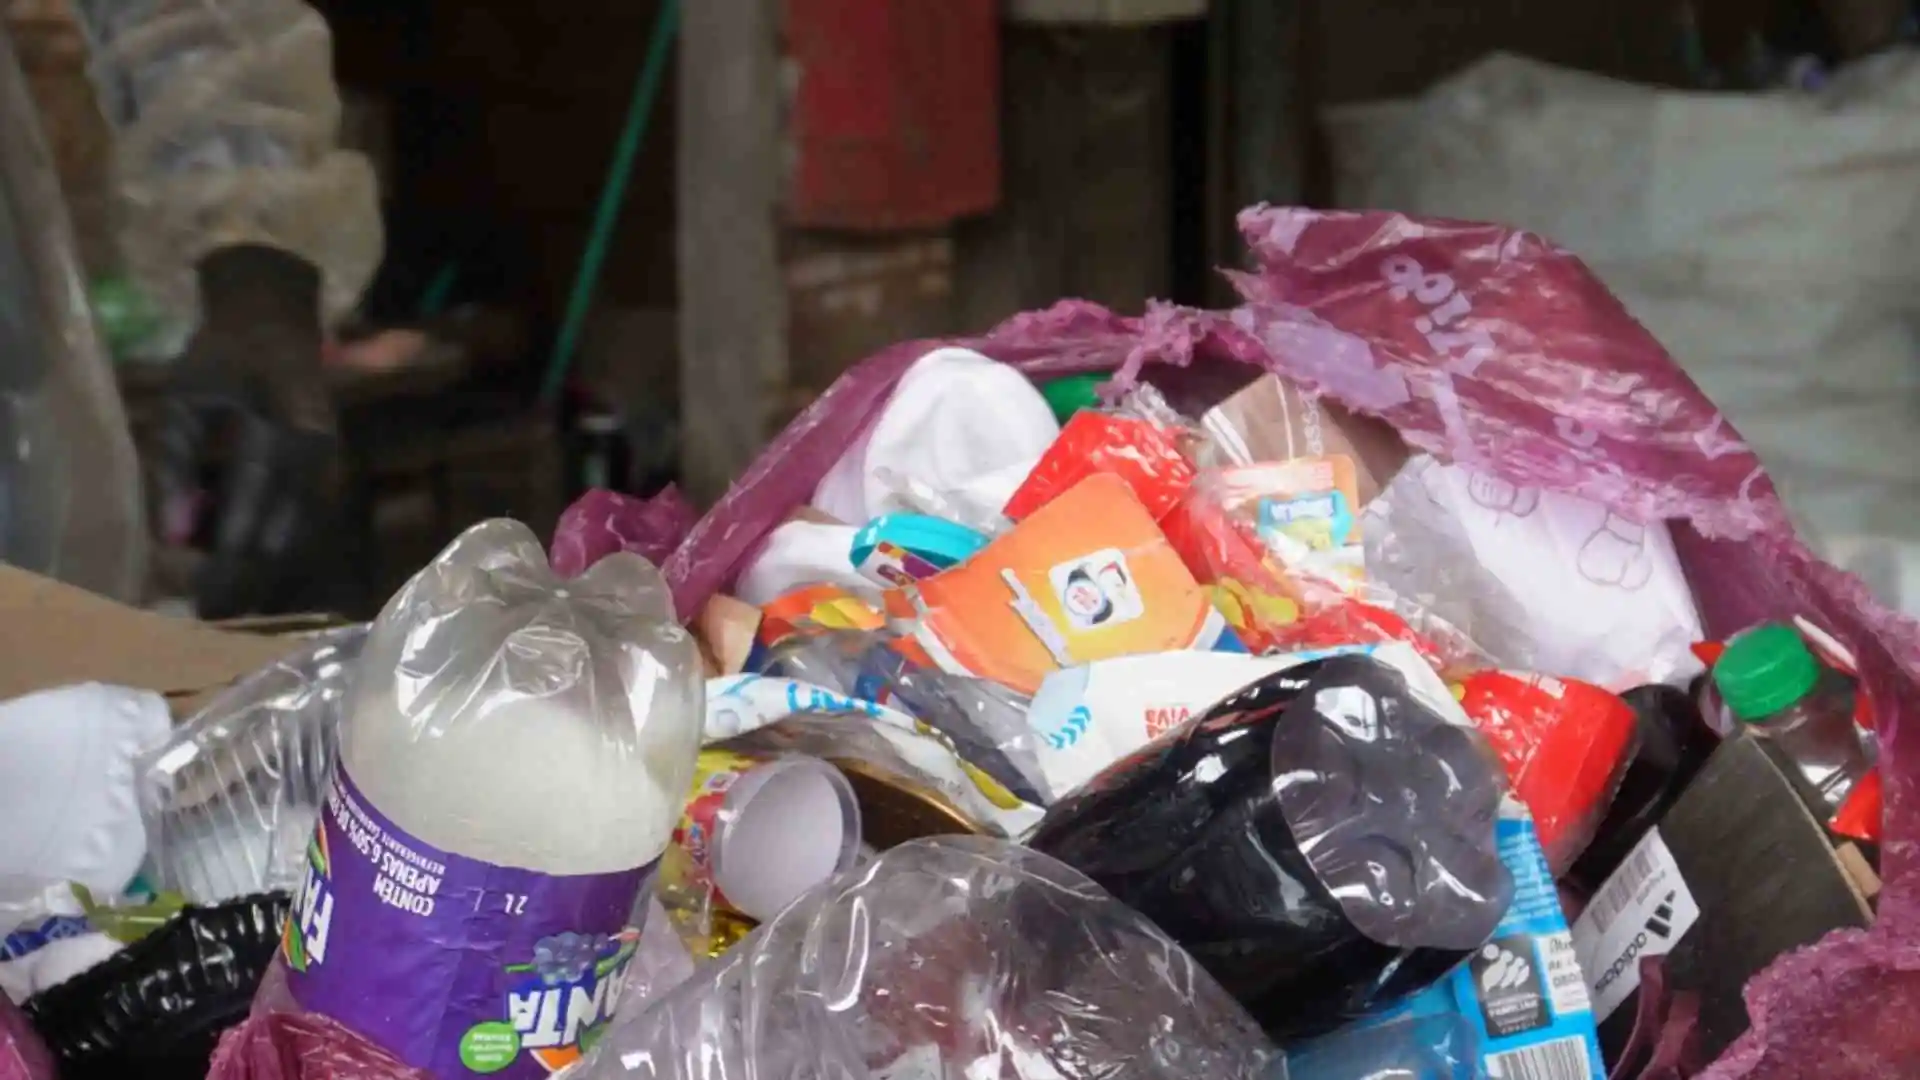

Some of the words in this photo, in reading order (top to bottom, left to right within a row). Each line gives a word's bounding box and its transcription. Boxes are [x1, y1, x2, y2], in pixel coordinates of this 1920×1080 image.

[372, 872, 435, 917] CONTÉM
[380, 851, 442, 895] APENAS
[1595, 931, 1649, 994] adidas
